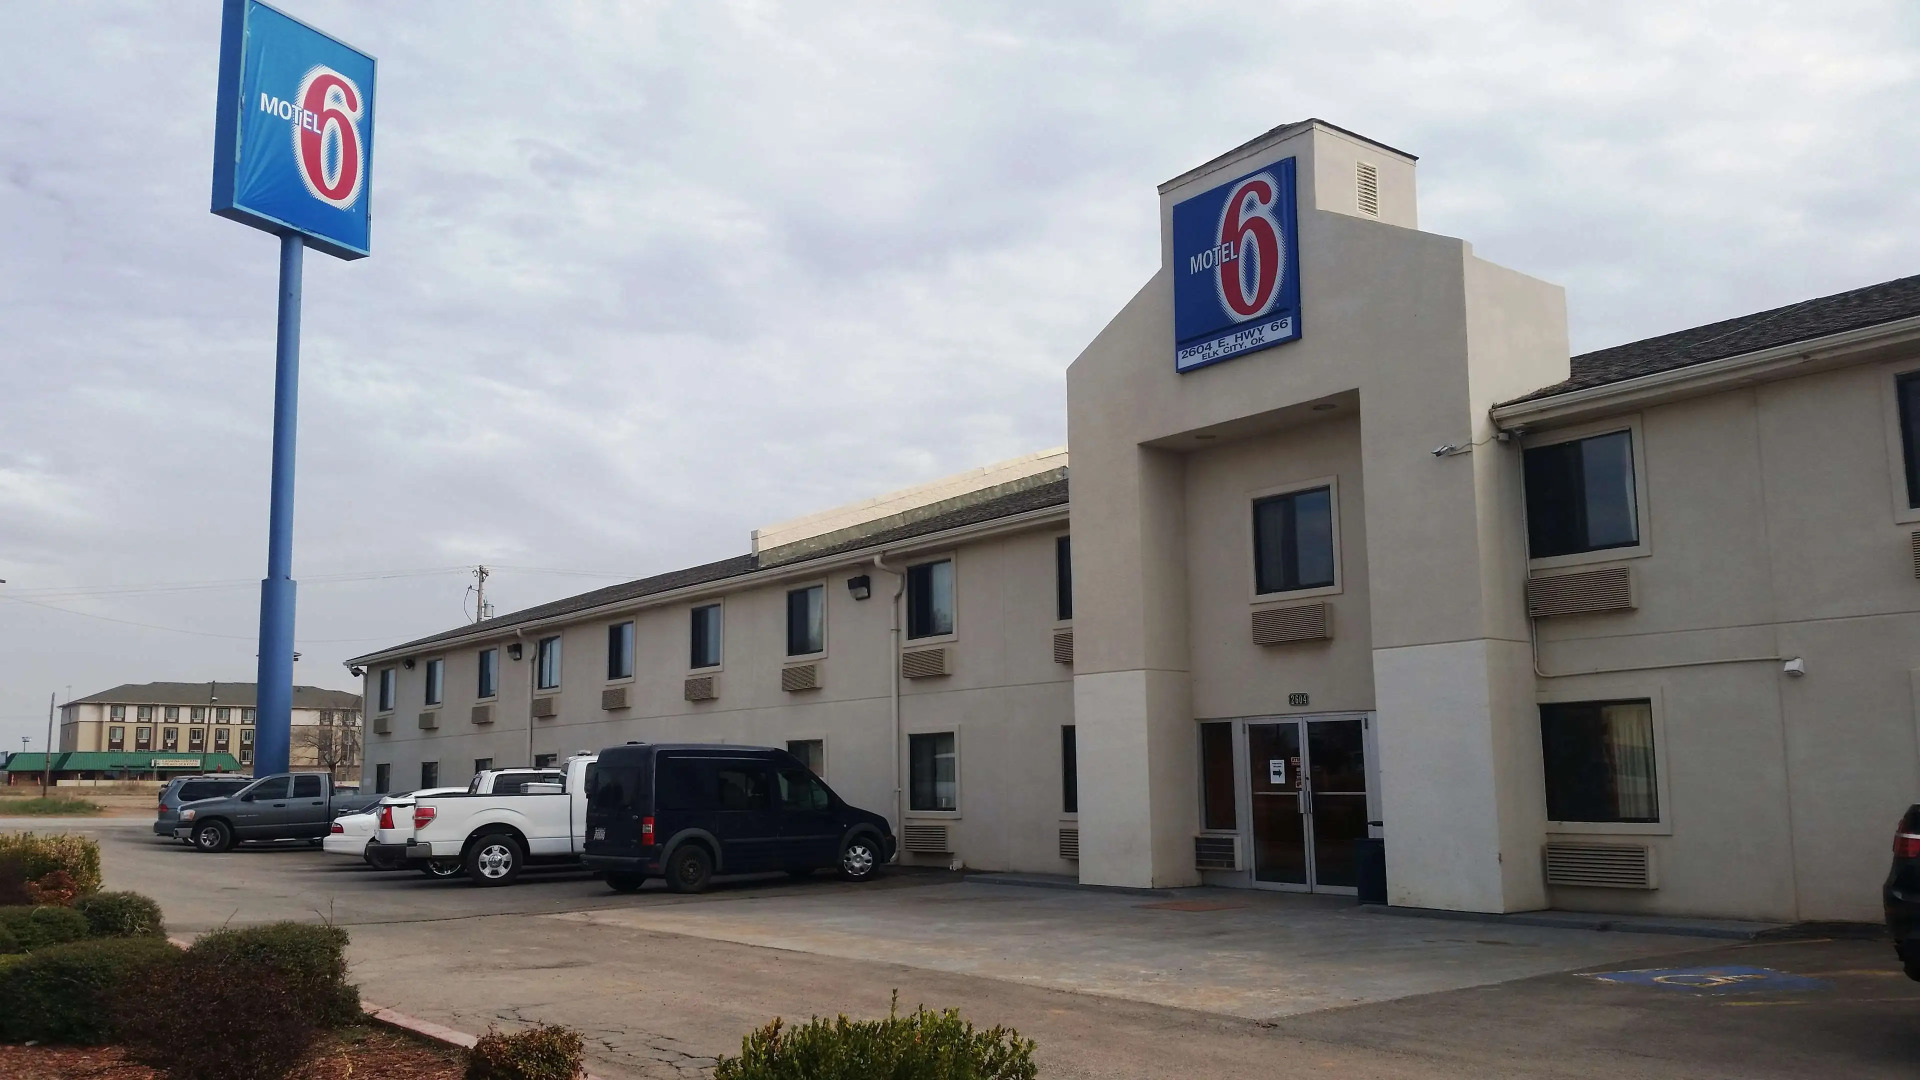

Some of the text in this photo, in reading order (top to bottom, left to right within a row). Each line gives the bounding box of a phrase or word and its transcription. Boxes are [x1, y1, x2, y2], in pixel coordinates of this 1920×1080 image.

[260, 71, 359, 203] MOTEL 6
[1190, 178, 1280, 317] MOTEL 6
[1181, 318, 1289, 360] 2604 E. HWY 66
[1201, 336, 1265, 361] ELK CITY, OK
